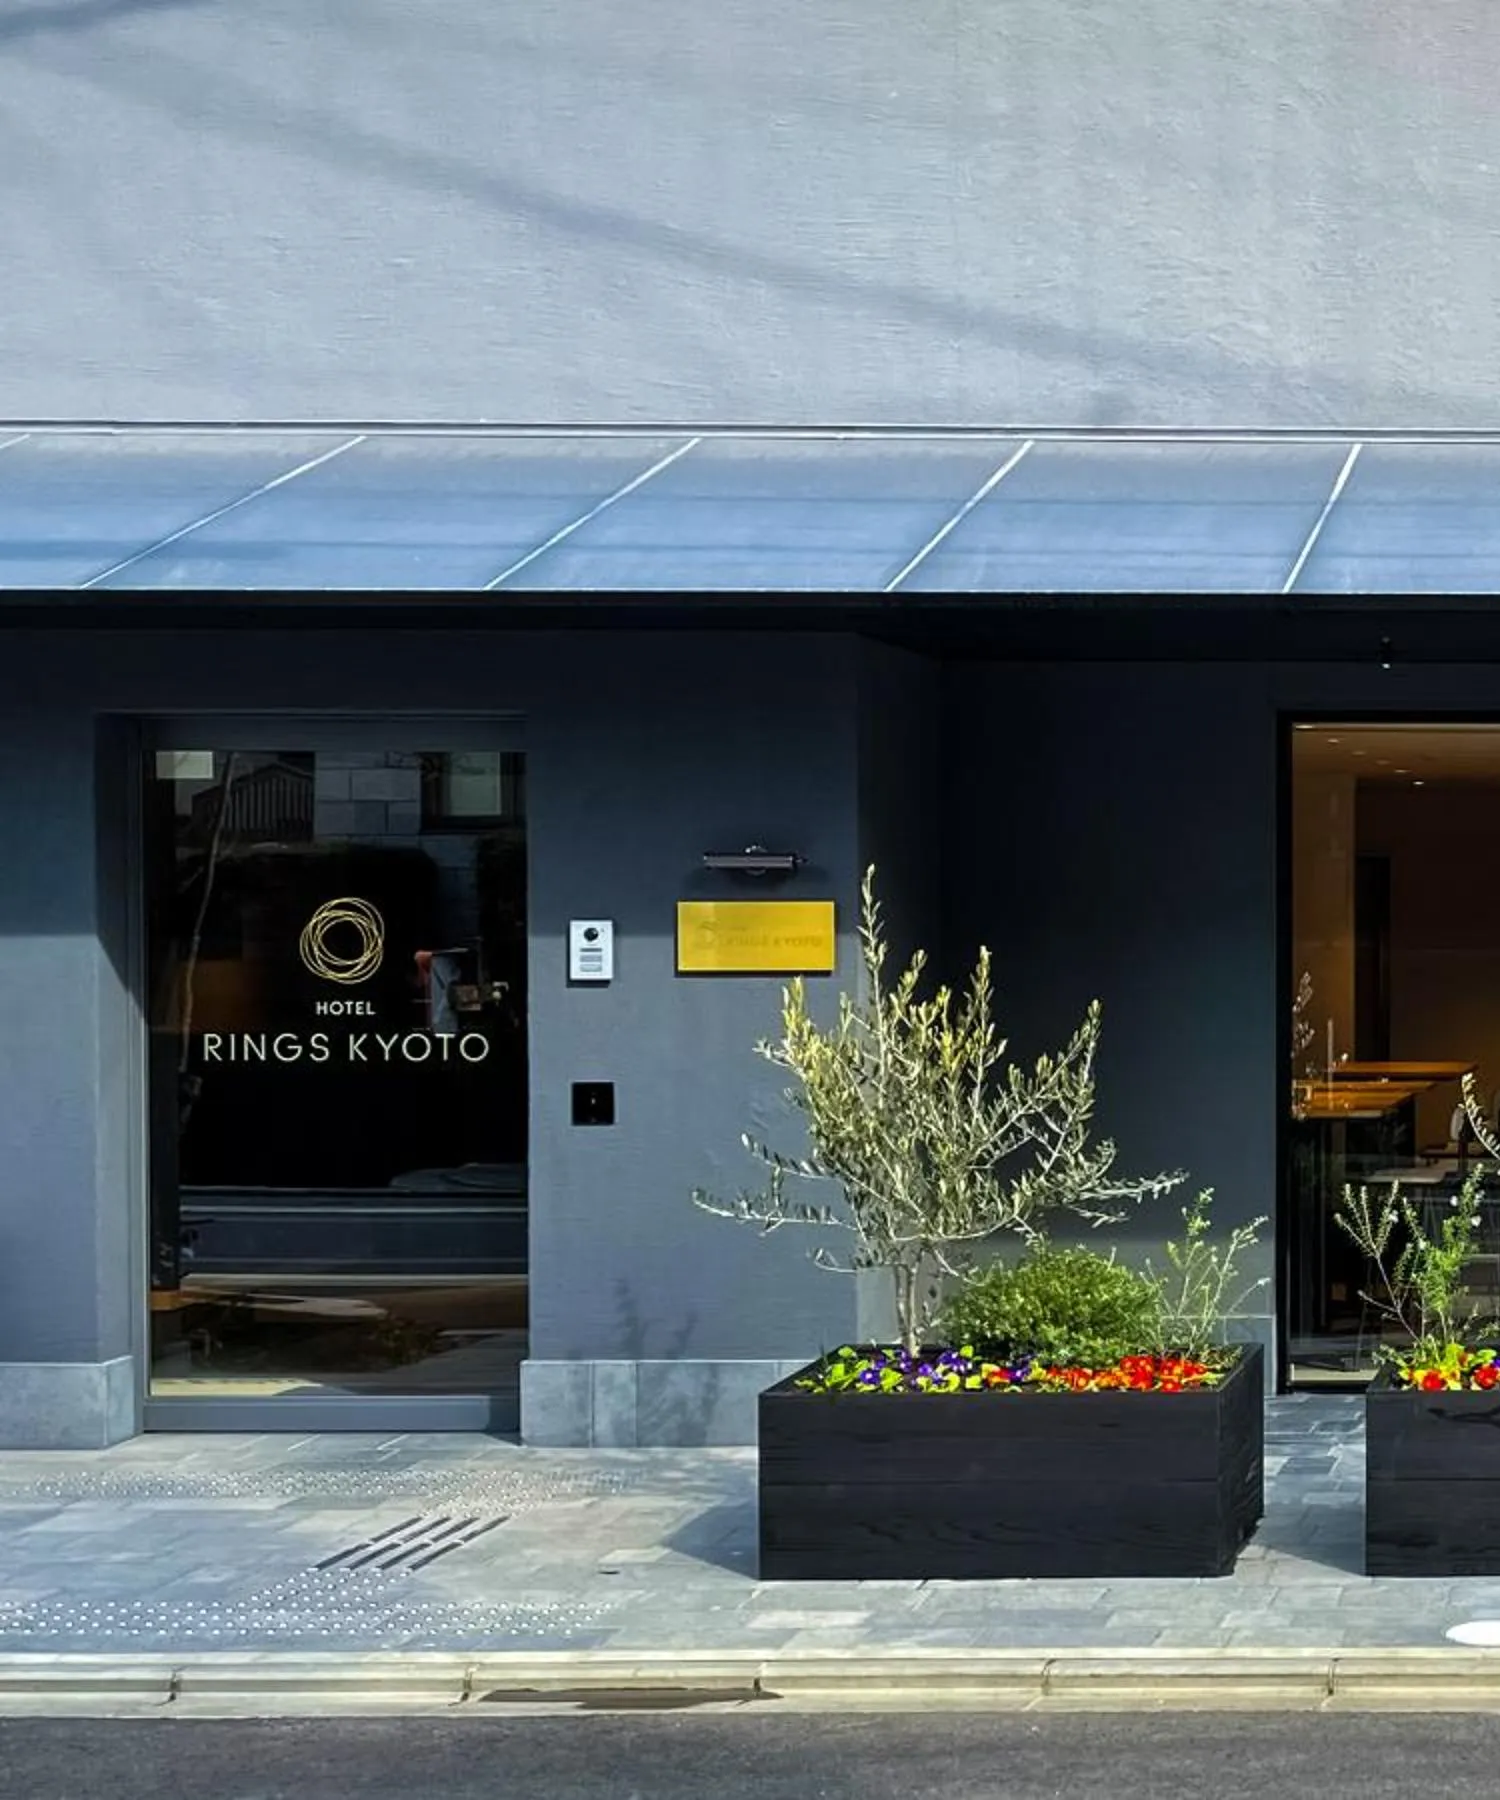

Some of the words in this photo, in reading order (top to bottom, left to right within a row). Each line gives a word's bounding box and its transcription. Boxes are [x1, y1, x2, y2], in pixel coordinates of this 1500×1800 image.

[315, 1001, 376, 1016] HOTEL
[203, 1033, 330, 1062] RINGS
[349, 1033, 490, 1062] KYOTO
